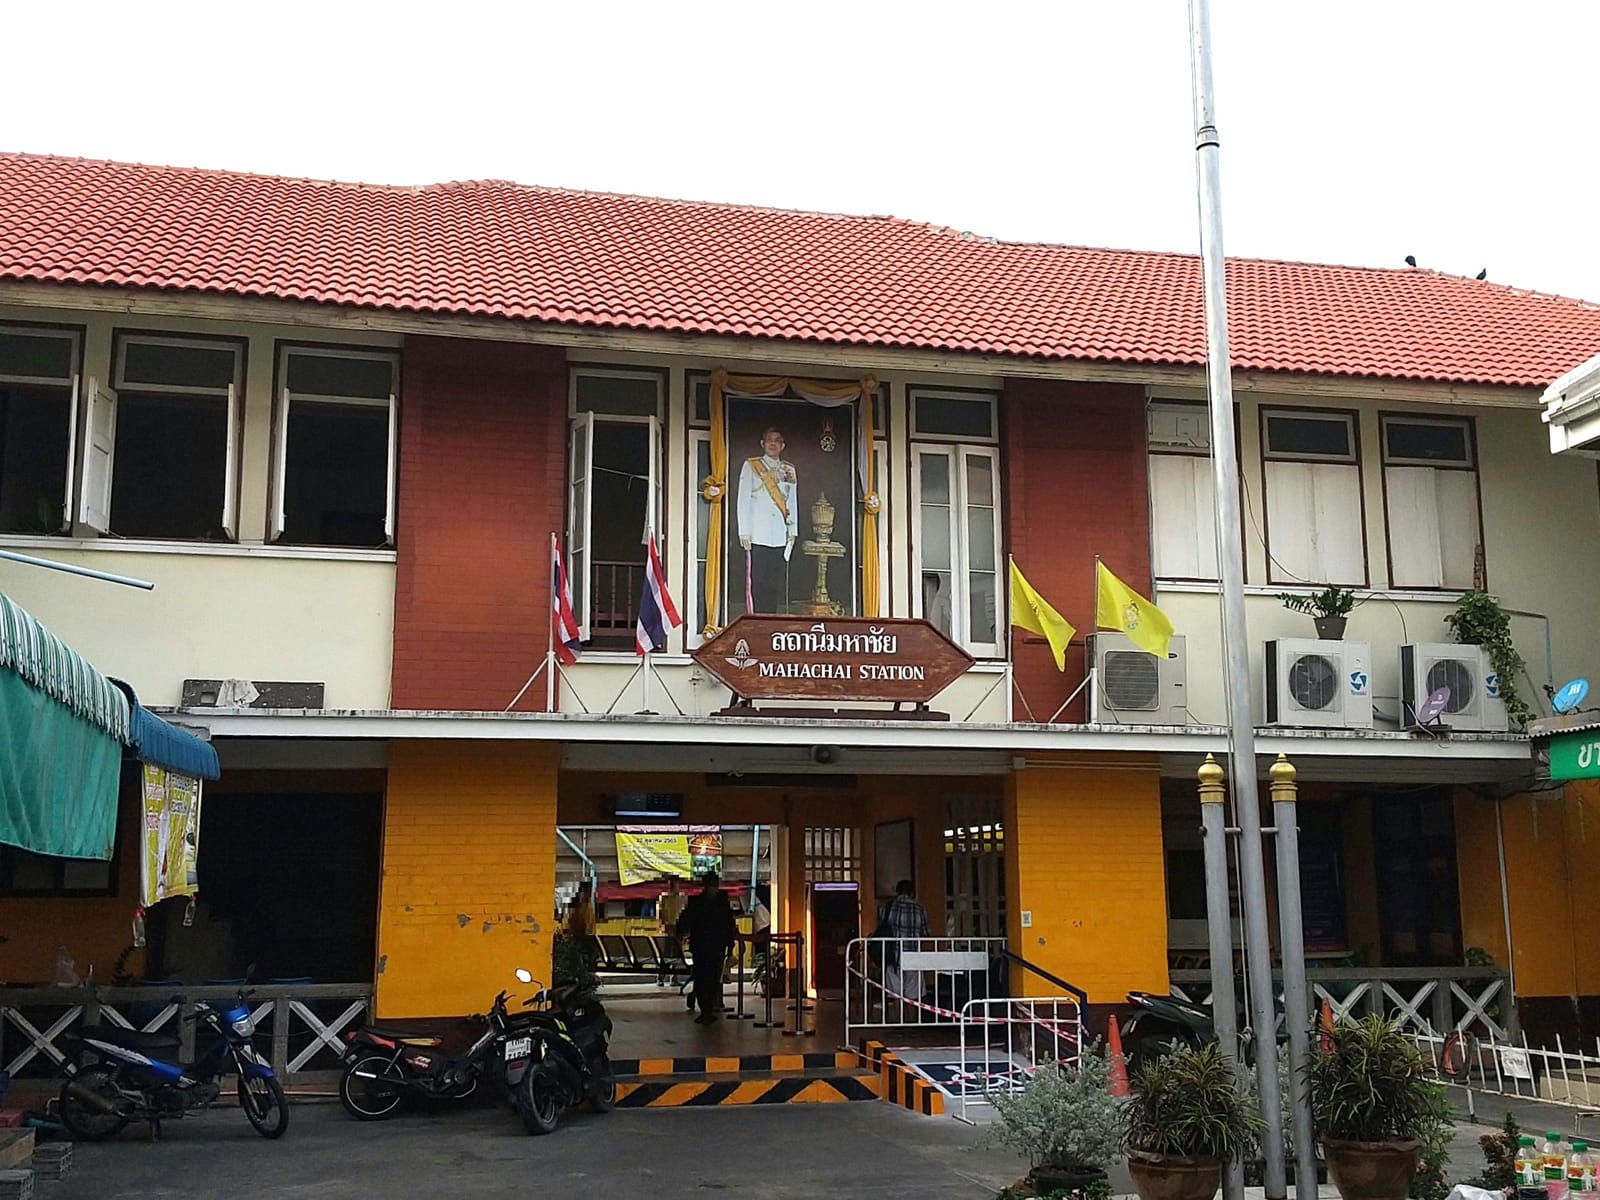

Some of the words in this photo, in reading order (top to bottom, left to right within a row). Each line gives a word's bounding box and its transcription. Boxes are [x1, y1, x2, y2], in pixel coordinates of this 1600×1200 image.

[771, 622, 897, 654] สถานีมหาชัย
[759, 663, 851, 679] MAHACHAI
[859, 664, 925, 680] STATION
